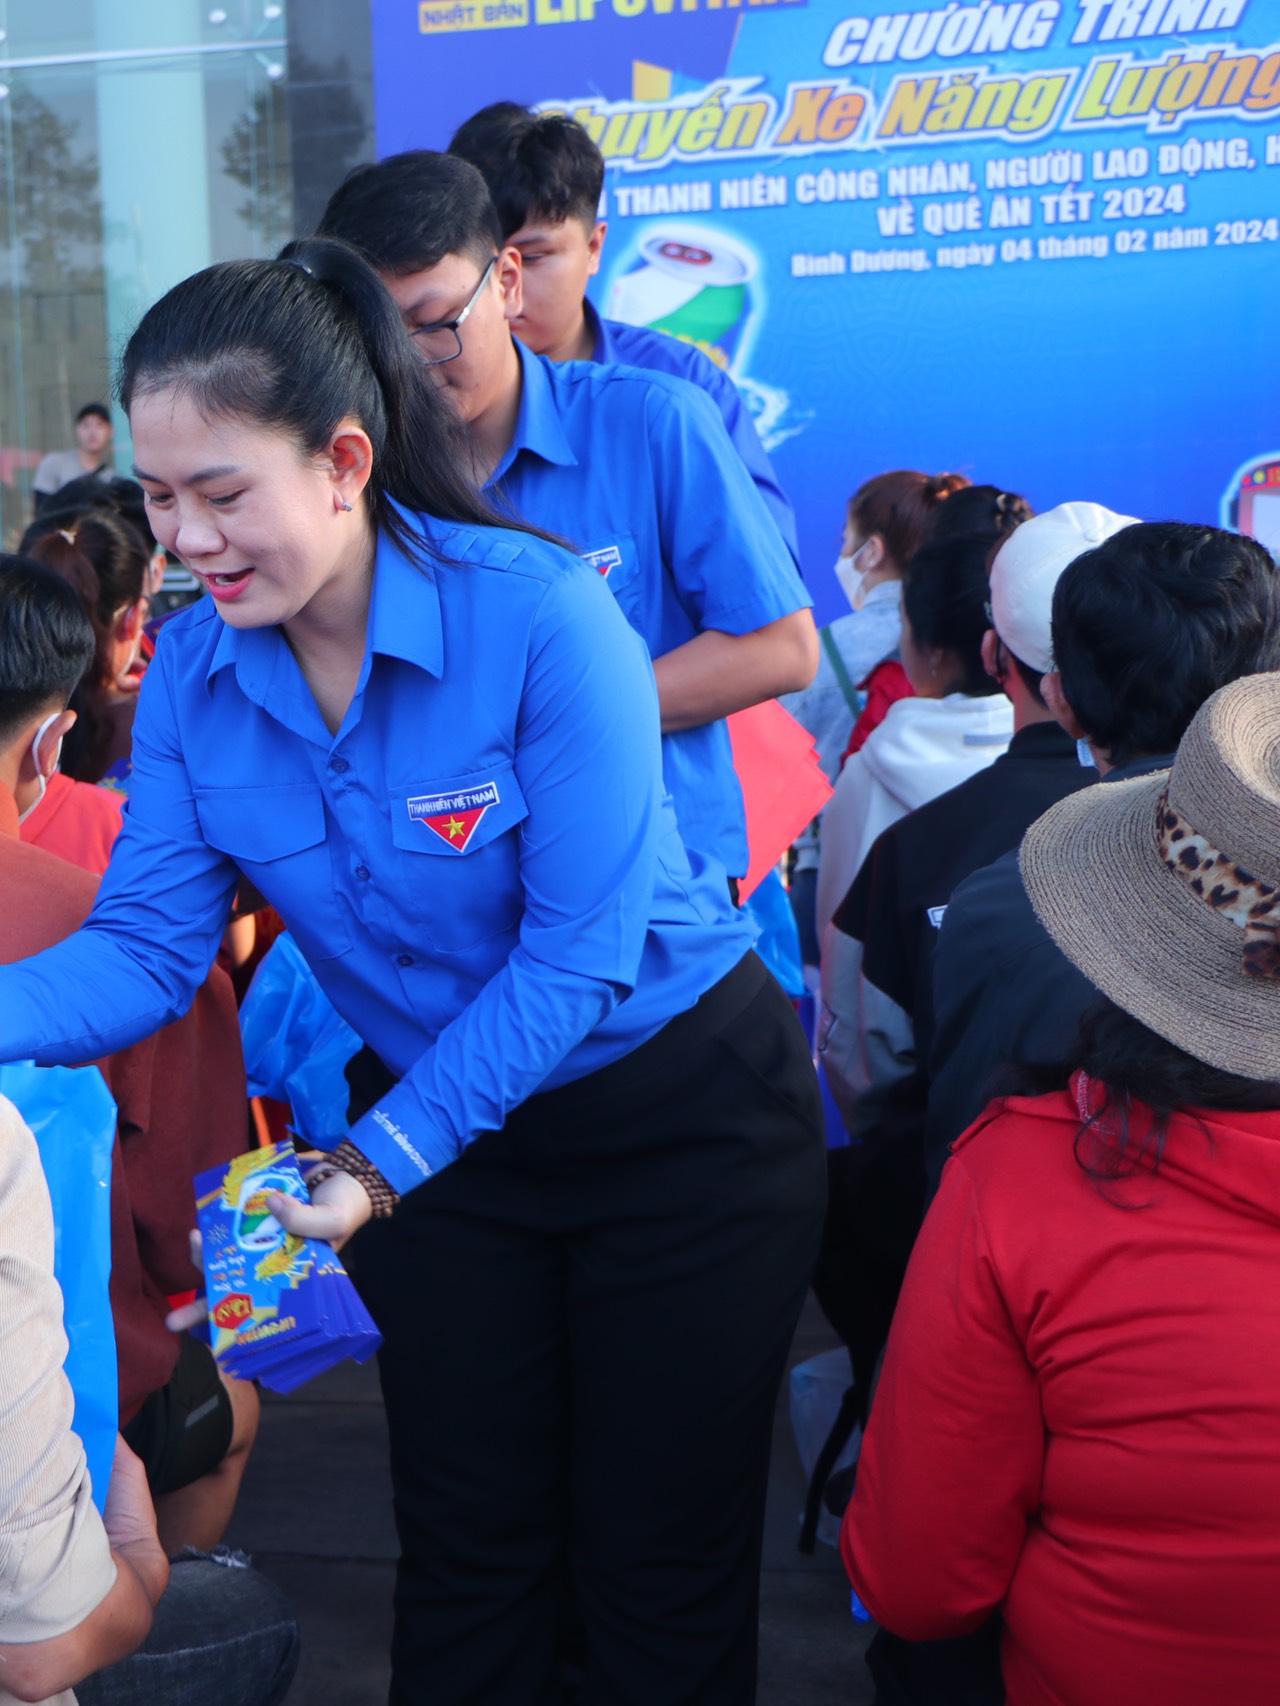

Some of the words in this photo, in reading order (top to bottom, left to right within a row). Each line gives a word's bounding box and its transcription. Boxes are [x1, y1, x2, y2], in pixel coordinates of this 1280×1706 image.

[538, 84, 770, 161] huyến
[775, 87, 868, 145] Xe
[879, 74, 1070, 136] Năng
[1075, 50, 1280, 122] Lượng
[615, 181, 712, 217] THANH
[721, 172, 787, 209] NIÊN
[795, 166, 879, 204] CÔNG
[888, 158, 978, 198] NHÂN,
[986, 148, 1083, 189] NGƯỜI
[1092, 147, 1148, 181] LAO
[1158, 137, 1257, 177] ĐỘNG,
[877, 197, 915, 237] VỀ
[922, 193, 982, 236] QUÊ
[989, 190, 1032, 229] ĂN
[1040, 183, 1095, 224] TẾT
[1103, 183, 1186, 219] 2024
[936, 241, 995, 269] ngày
[1001, 238, 1032, 262] 04
[1038, 234, 1108, 259] tháng
[1115, 229, 1146, 253] 02
[1153, 226, 1208, 251] năm
[1215, 218, 1278, 245] 2024
[409, 801, 433, 815] THANH
[432, 797, 451, 812] NIÊN
[451, 793, 471, 810] VIỆT
[471, 788, 495, 804] NAM
